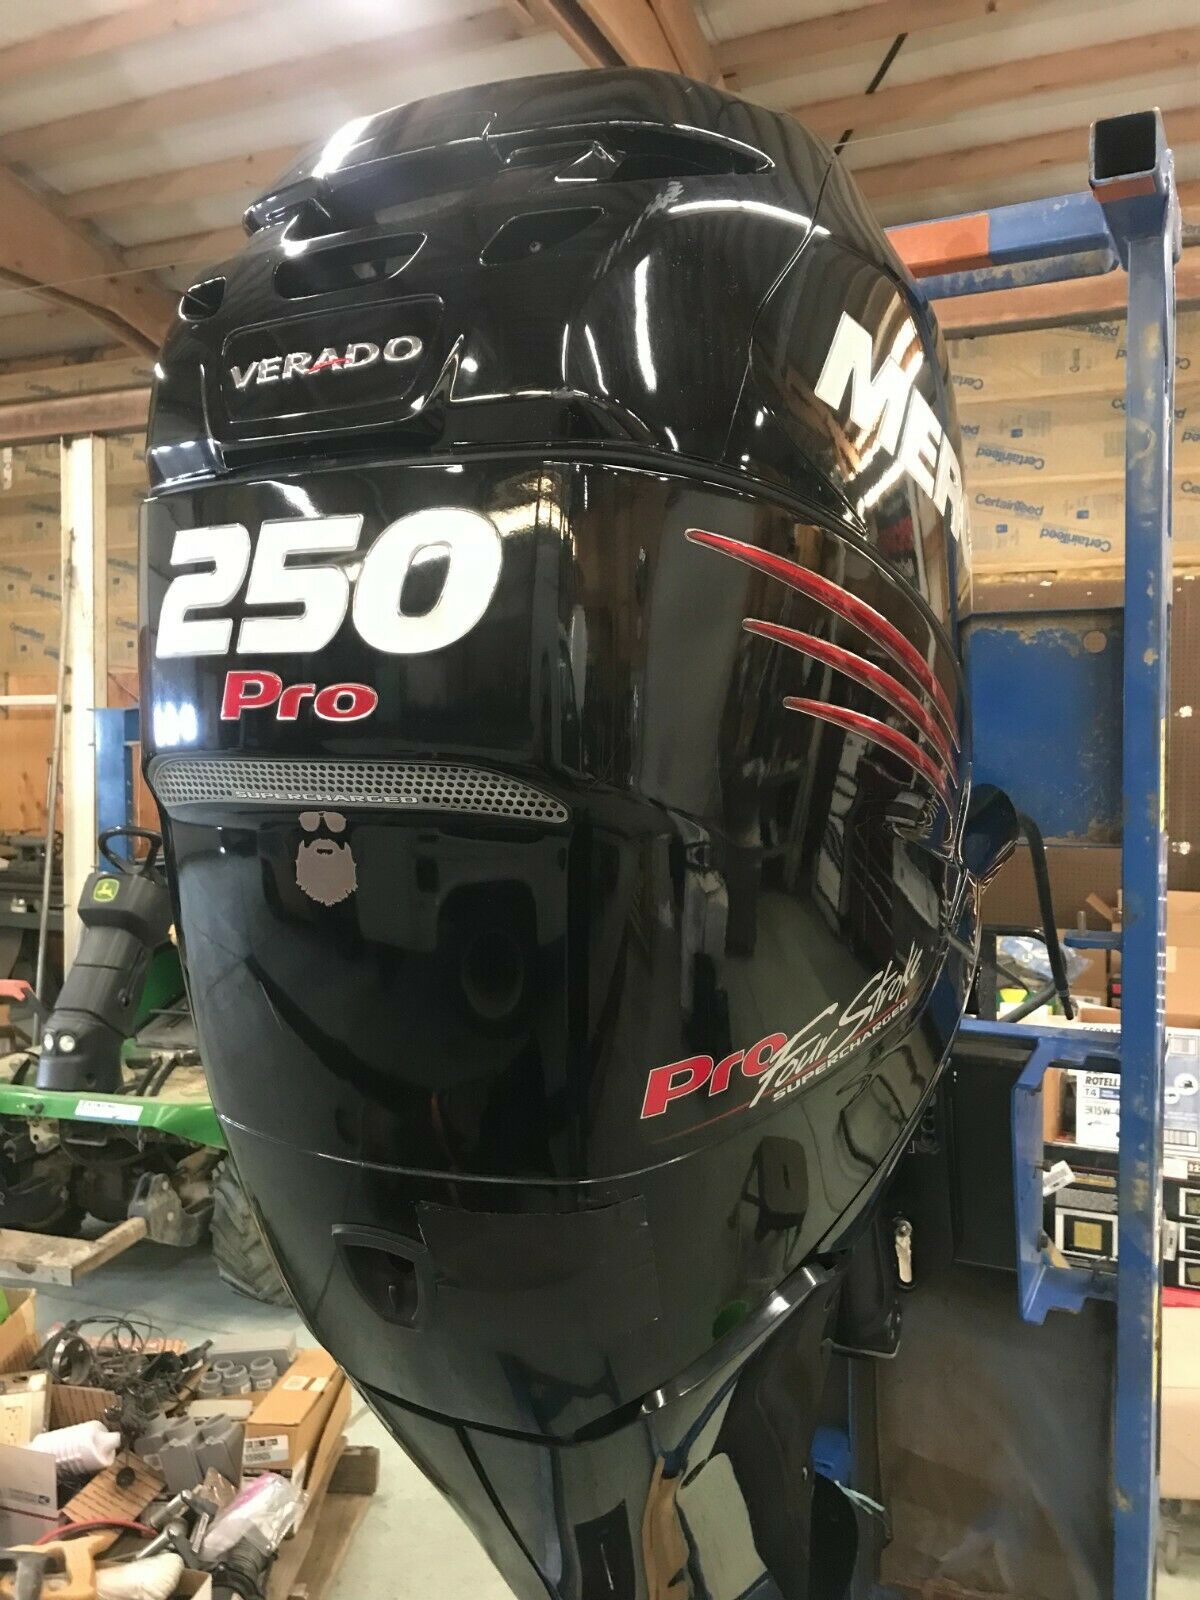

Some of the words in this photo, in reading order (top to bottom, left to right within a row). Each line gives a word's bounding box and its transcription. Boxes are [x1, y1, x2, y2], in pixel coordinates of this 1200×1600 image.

[230, 335, 423, 390] VERADO
[156, 507, 503, 659] 250
[220, 670, 379, 721] Pro
[234, 790, 418, 804] SUPERCHARGED
[640, 1032, 788, 1119] Pro
[749, 1002, 839, 1108] Four
[773, 998, 909, 1102] SUPERCHARGED
[1085, 1076, 1120, 1088] ROTELL
